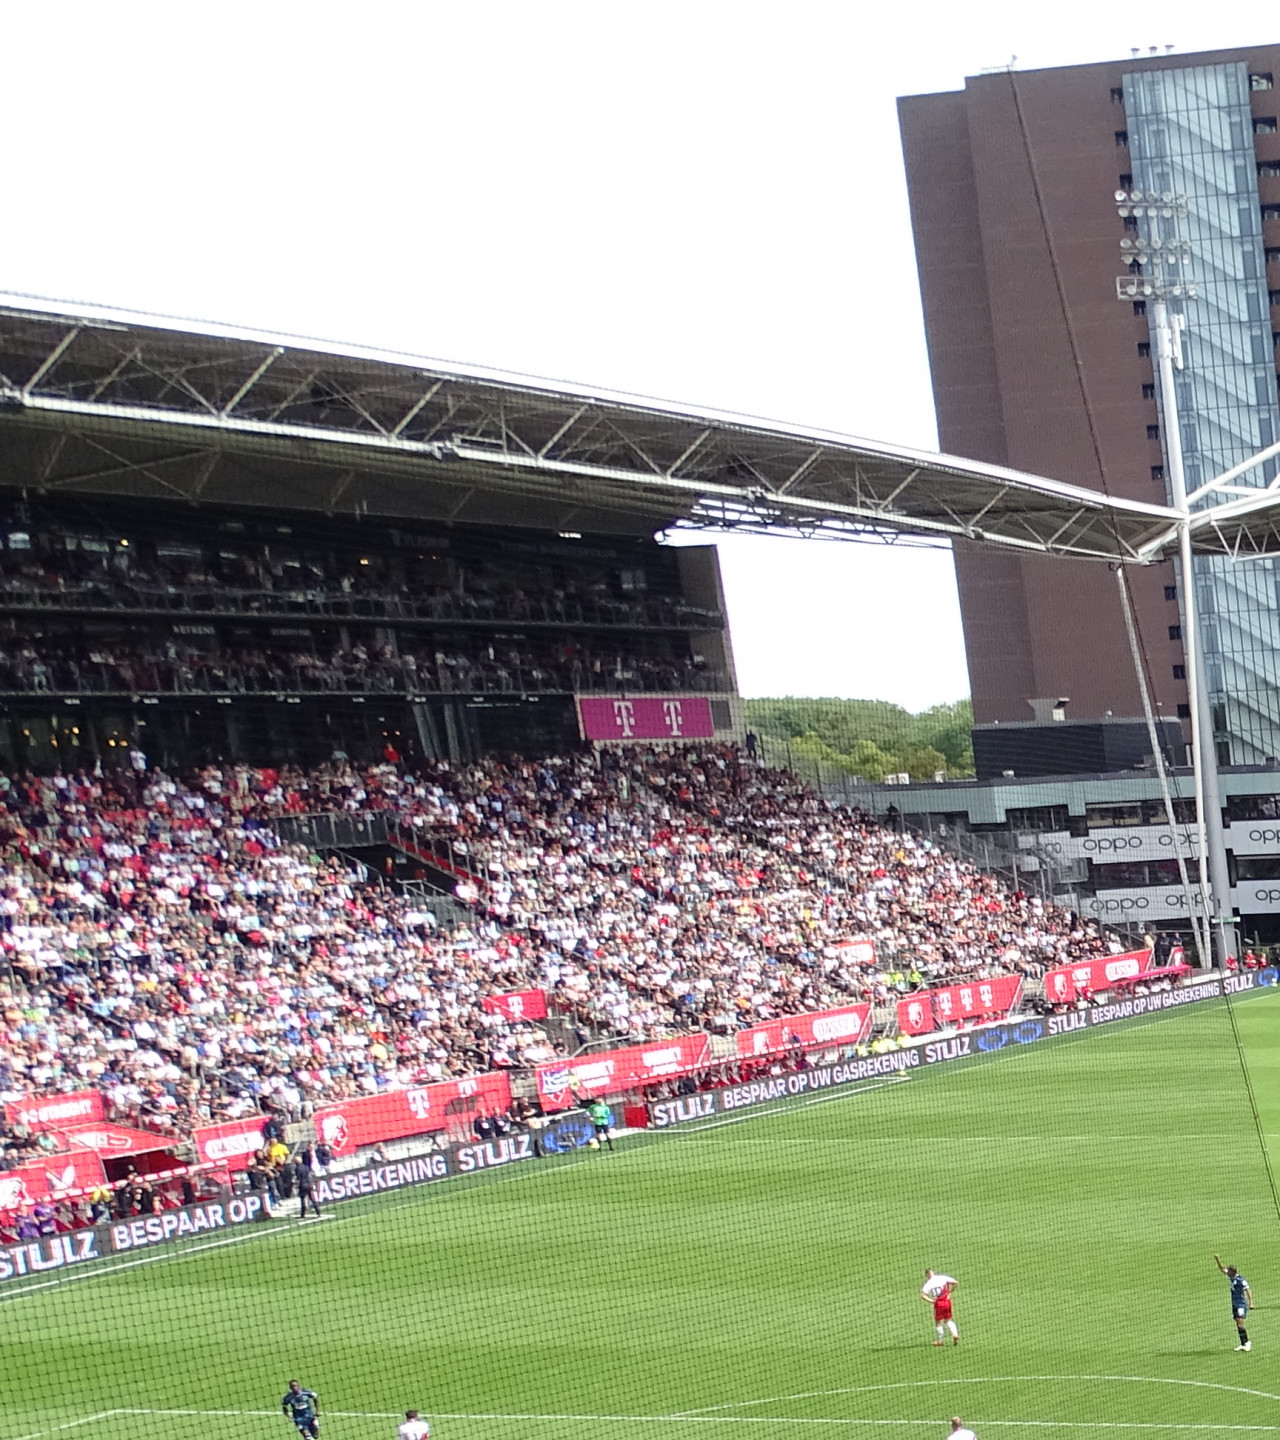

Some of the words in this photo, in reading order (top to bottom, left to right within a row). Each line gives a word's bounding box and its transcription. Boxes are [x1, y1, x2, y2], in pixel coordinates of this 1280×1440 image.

[1224, 974, 1254, 994] STULZ
[1092, 1002, 1132, 1024] BESPAAR
[1134, 998, 1146, 1014] OP
[1147, 994, 1161, 1011] UW
[1163, 982, 1219, 1007] GASREKENING
[1048, 1012, 1087, 1034] STULZ
[926, 1037, 971, 1063] STULZ
[724, 1078, 787, 1109] BESPAAR
[789, 1073, 808, 1094] OP
[810, 1068, 831, 1089] UW
[833, 1050, 919, 1083] GASREKENING
[653, 1094, 715, 1125] STULZ
[458, 1134, 533, 1172] STULZ
[112, 1203, 225, 1250] BESPAAR
[229, 1196, 261, 1222] OP
